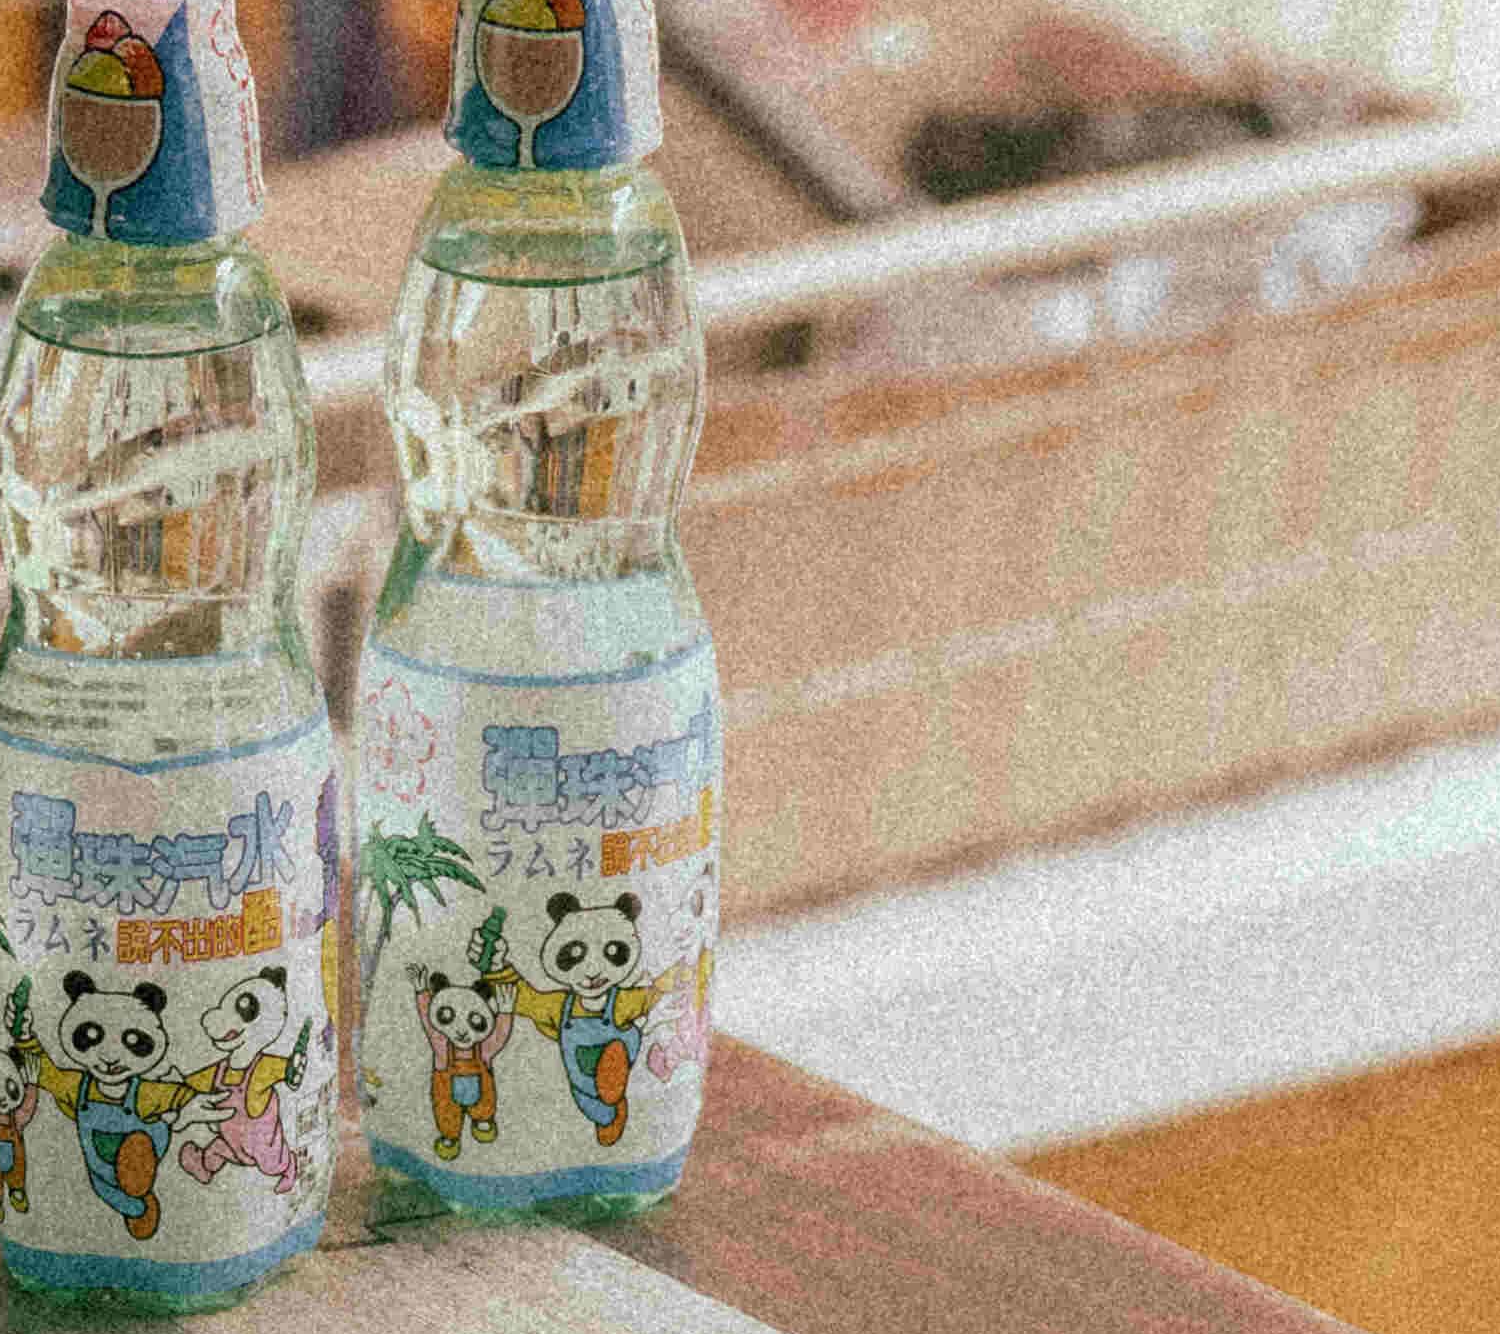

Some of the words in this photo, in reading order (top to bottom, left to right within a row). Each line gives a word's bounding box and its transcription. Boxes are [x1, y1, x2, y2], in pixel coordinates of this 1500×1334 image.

[486, 837, 597, 882] ラムネ
[14, 906, 113, 962] ラムネ
